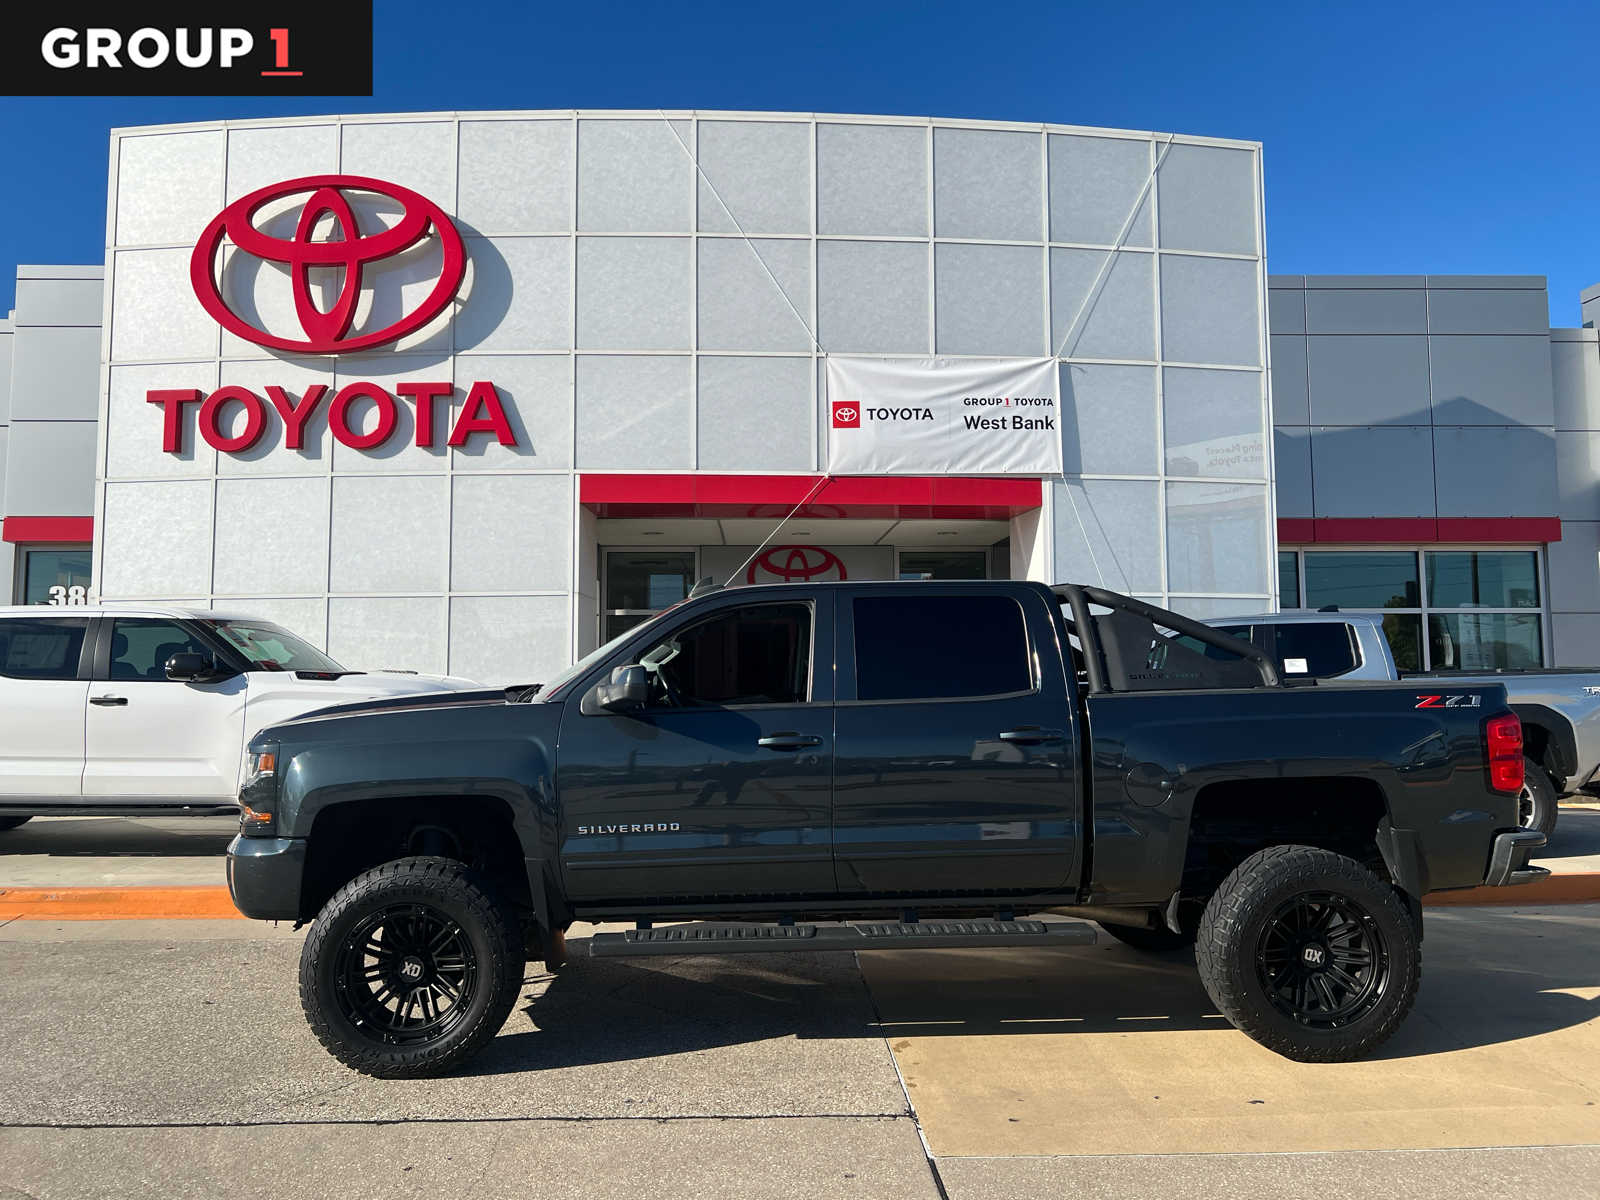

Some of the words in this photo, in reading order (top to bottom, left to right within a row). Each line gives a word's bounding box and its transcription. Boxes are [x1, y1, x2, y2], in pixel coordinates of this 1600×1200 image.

[963, 397, 1003, 407] GROUP
[1003, 397, 1011, 407] 1
[1014, 397, 1054, 406] TOYOTA
[146, 381, 519, 454] TOYOTA
[867, 407, 934, 421] TOYOTA
[963, 415, 1008, 430] West
[1012, 415, 1055, 430] Bank
[1414, 694, 1482, 708] Z71
[578, 822, 680, 834] SILVERADO
[401, 960, 421, 977] XD
